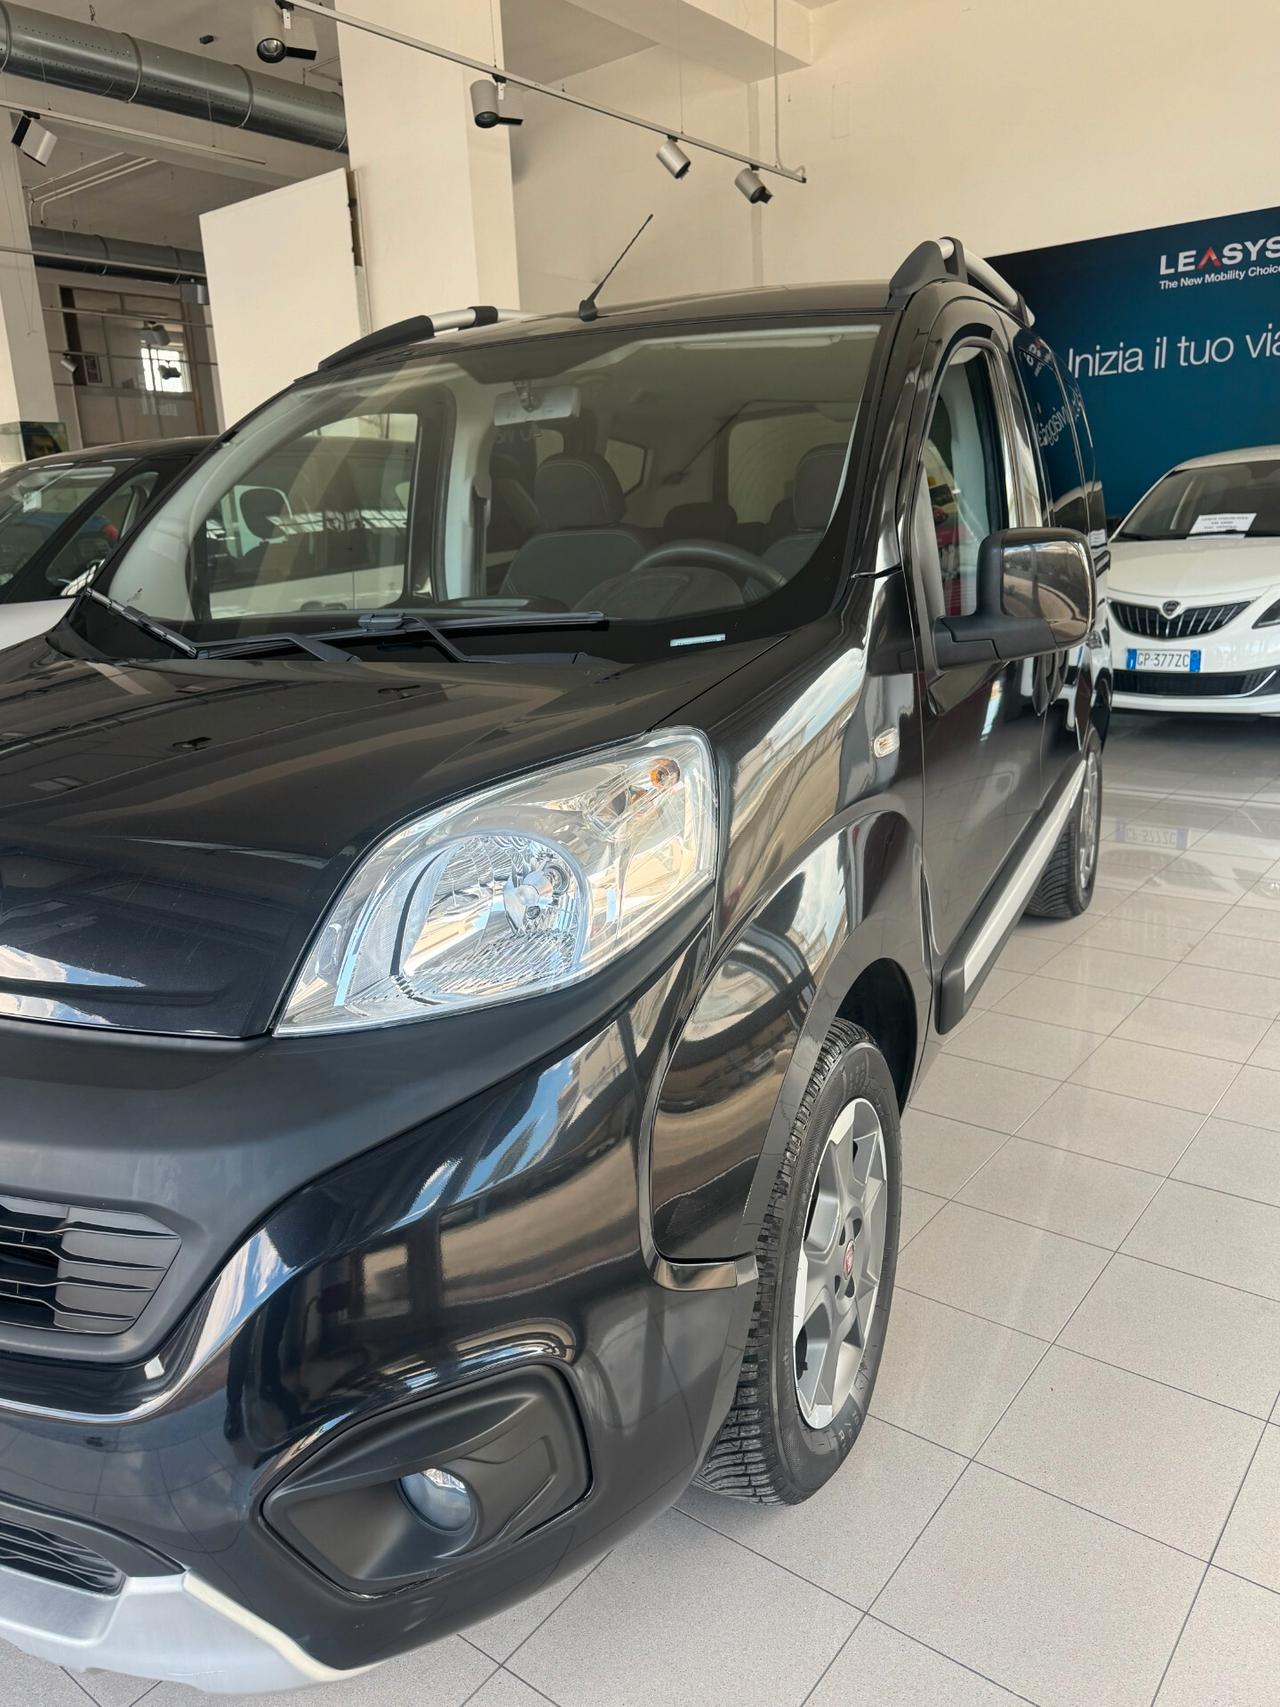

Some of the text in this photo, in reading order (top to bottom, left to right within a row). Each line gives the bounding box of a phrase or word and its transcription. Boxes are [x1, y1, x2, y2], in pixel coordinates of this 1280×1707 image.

[1159, 264, 1280, 290] The New Mobility Choic
[1068, 341, 1144, 378] Inizia
[1154, 336, 1167, 369] il
[1177, 336, 1234, 366] tuo
